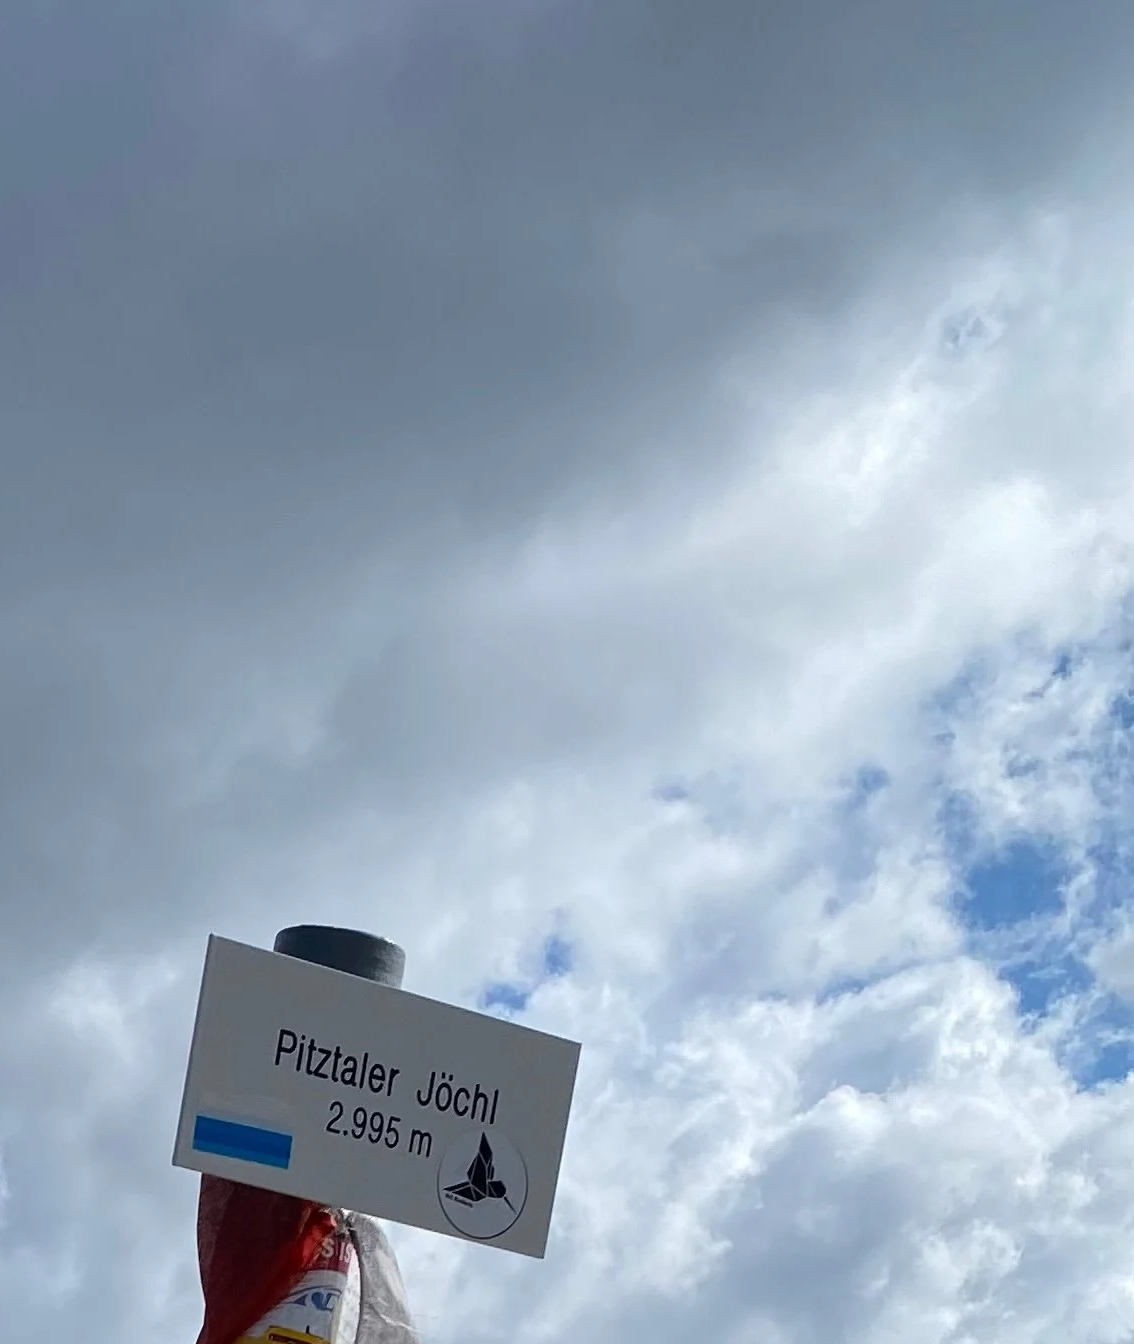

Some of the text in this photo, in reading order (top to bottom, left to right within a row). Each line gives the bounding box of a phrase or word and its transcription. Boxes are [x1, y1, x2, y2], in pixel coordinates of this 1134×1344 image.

[275, 1028, 500, 1125] Pitztaler Jöchl
[326, 1101, 433, 1158] 2.995 m
